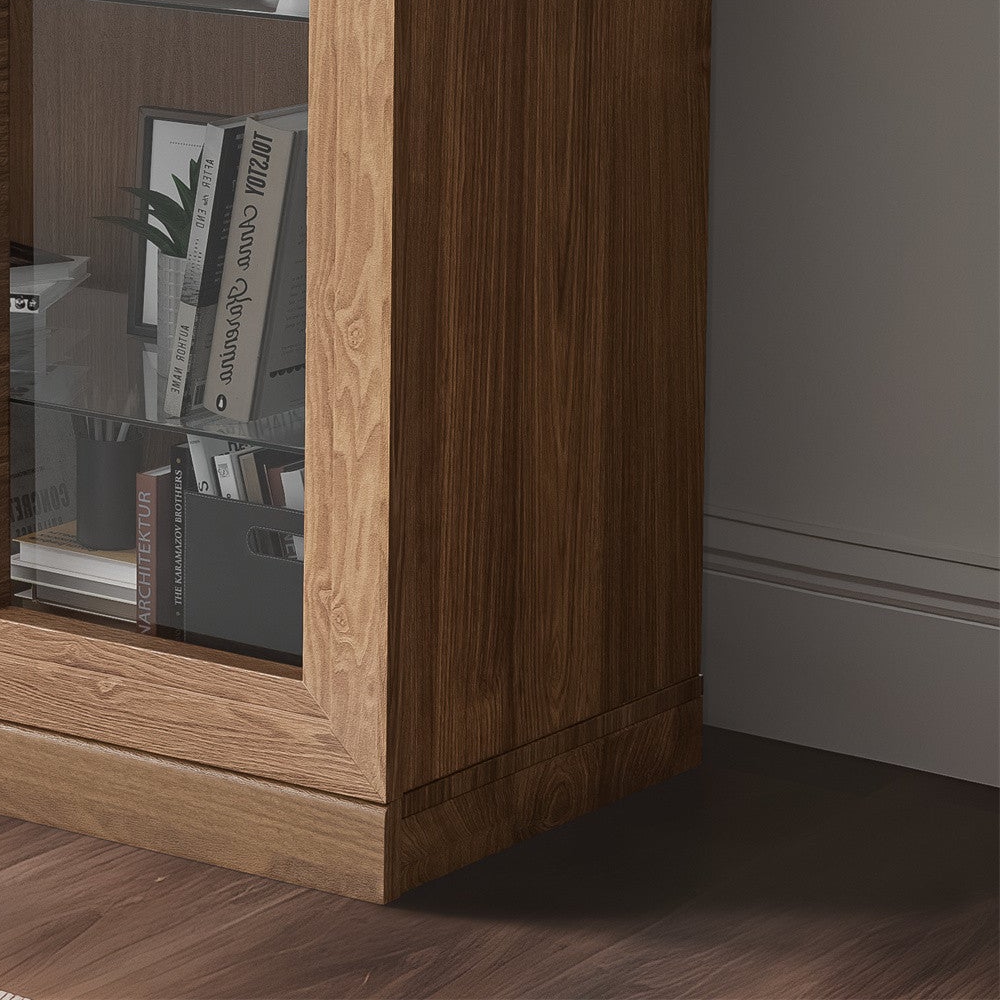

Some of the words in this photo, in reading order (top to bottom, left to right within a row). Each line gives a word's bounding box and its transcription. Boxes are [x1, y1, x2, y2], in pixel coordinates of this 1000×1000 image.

[174, 469, 183, 523] BROTHERS
[174, 524, 183, 584] KARAMAZOV
[174, 586, 183, 606] THE
